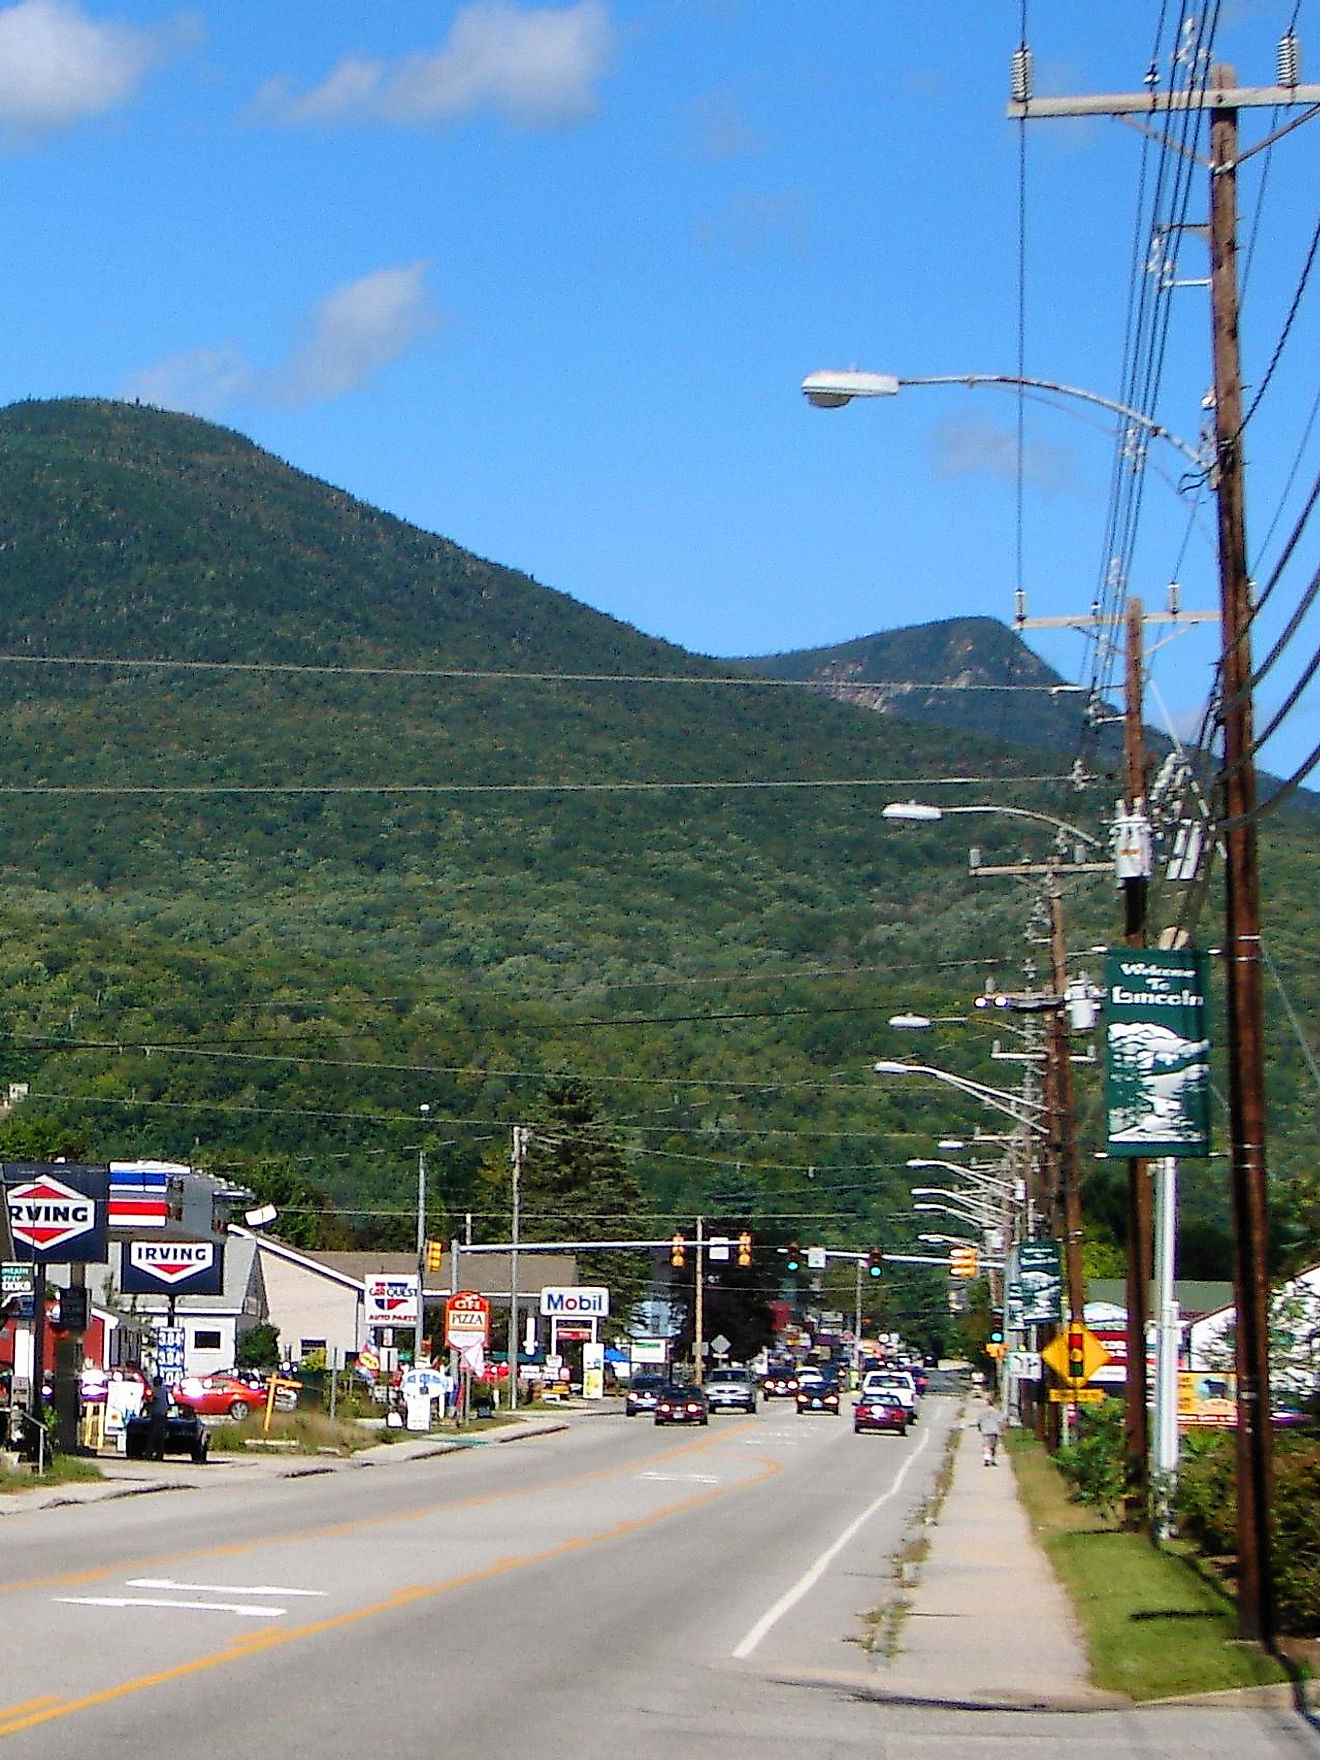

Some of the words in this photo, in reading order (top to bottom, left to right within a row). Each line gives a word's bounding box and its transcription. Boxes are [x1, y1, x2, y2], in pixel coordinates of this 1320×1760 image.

[1145, 978, 1171, 991] To
[1112, 986, 1205, 1006] Lincoln
[8, 1205, 89, 1222] RVING
[137, 1247, 207, 1261] IRVING
[547, 1294, 602, 1311] Mobil
[452, 1313, 483, 1325] PIZZA
